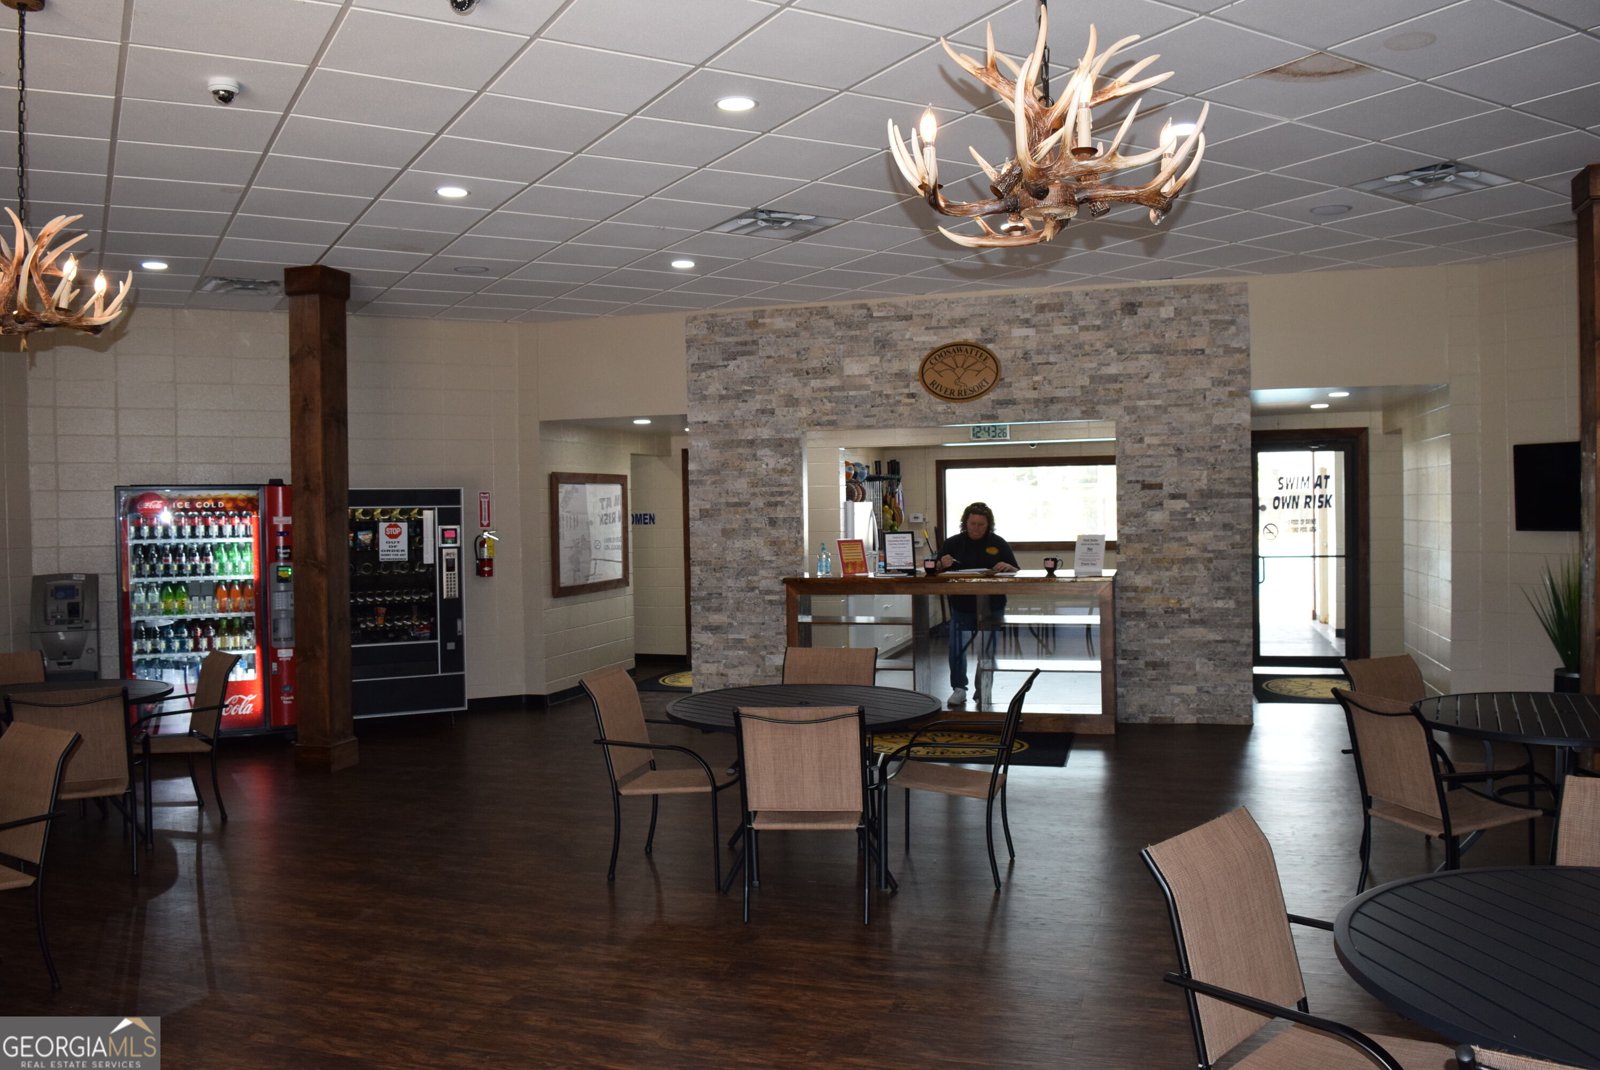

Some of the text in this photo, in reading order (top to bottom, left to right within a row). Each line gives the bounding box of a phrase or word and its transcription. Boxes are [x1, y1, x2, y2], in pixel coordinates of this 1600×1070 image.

[929, 346, 989, 365] COOSAWATTEE
[929, 379, 990, 397] RIVER RESORT
[1278, 475, 1331, 490] SWIM AT
[1272, 494, 1333, 510] OWN RISK
